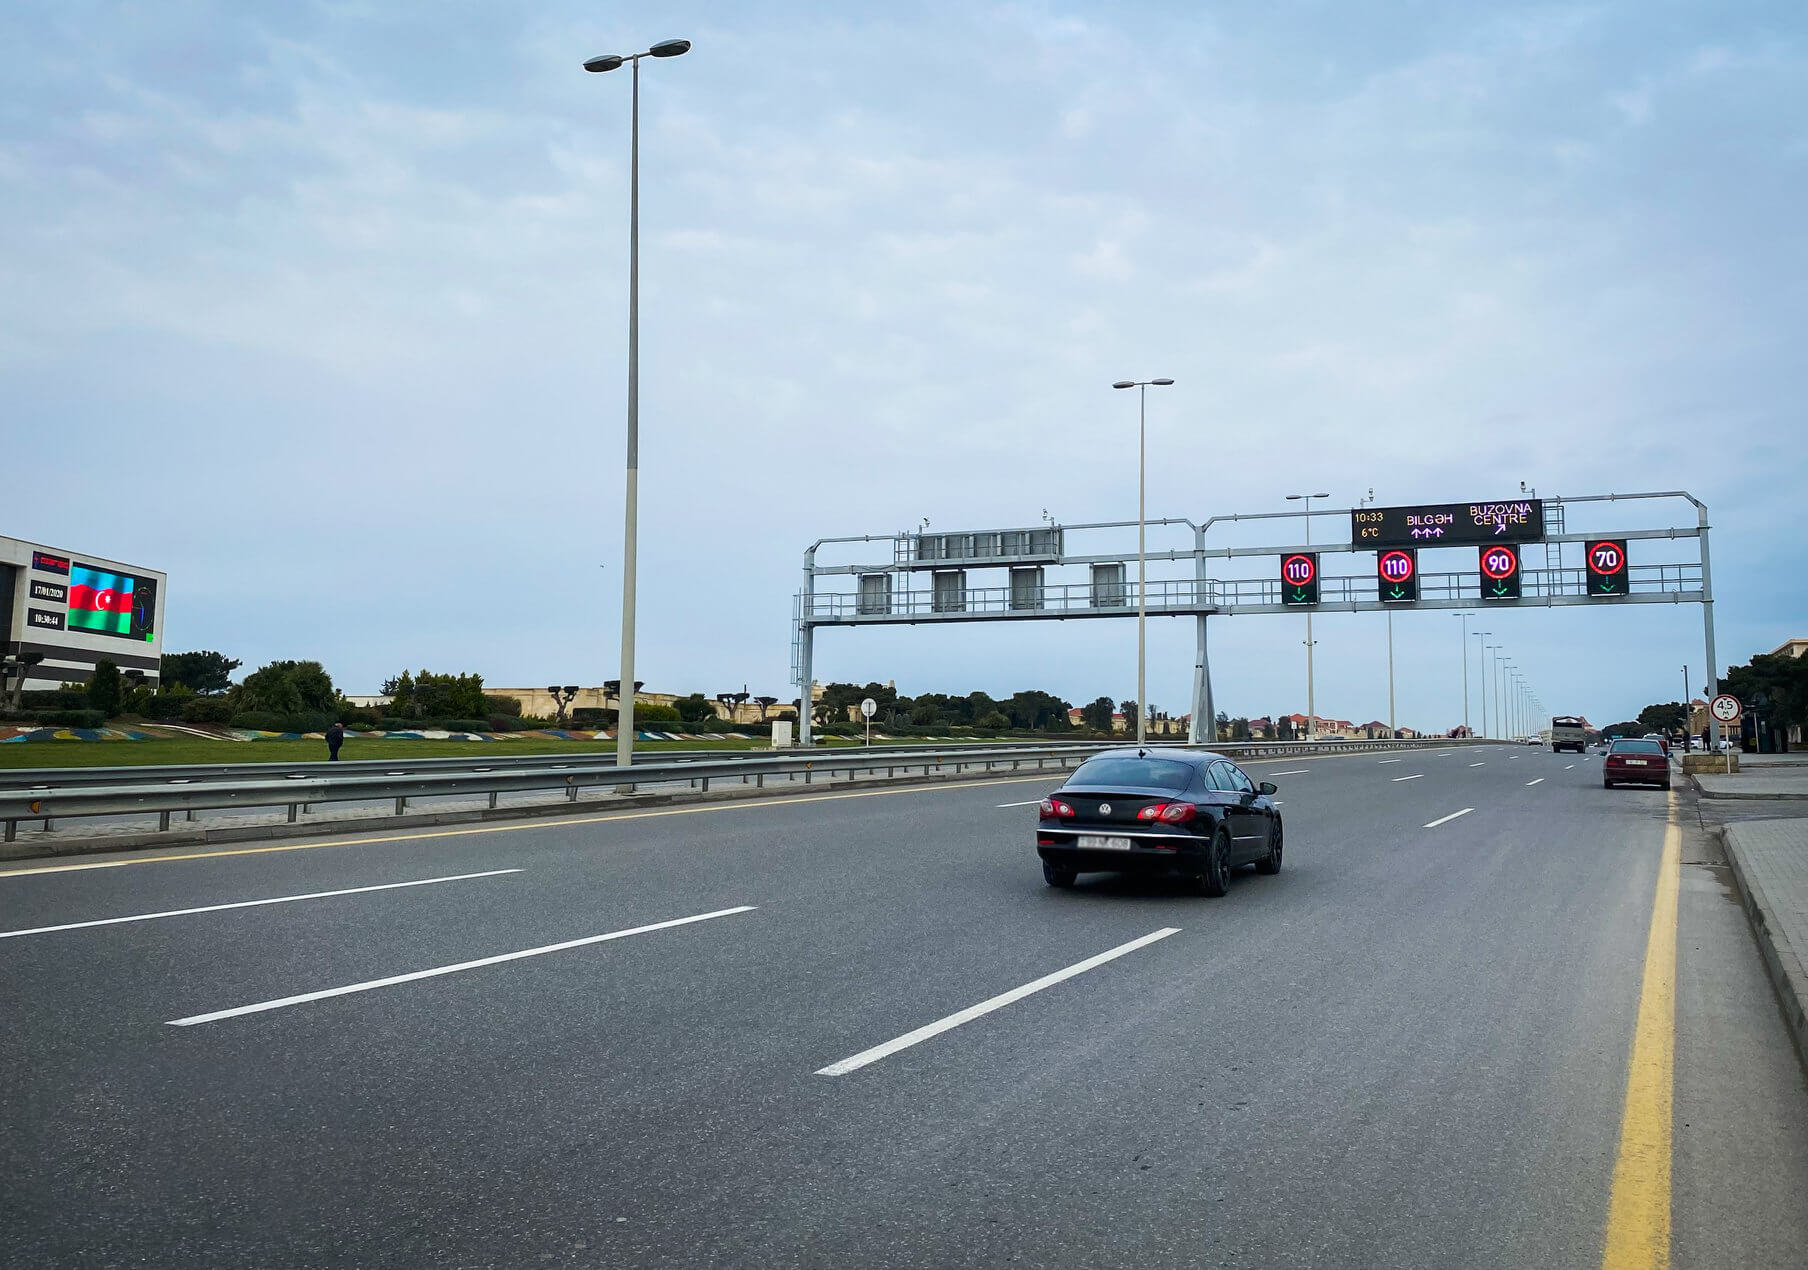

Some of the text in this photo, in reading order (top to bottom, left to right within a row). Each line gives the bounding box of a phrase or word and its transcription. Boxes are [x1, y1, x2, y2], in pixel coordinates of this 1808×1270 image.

[1355, 512, 1384, 523] 10:33
[1469, 503, 1533, 516] BUZOVNA
[1473, 513, 1528, 526] CENTRE
[1488, 554, 1509, 571] 90
[1595, 550, 1617, 567] 70
[1288, 563, 1309, 579] 110
[1385, 558, 1408, 576] 110
